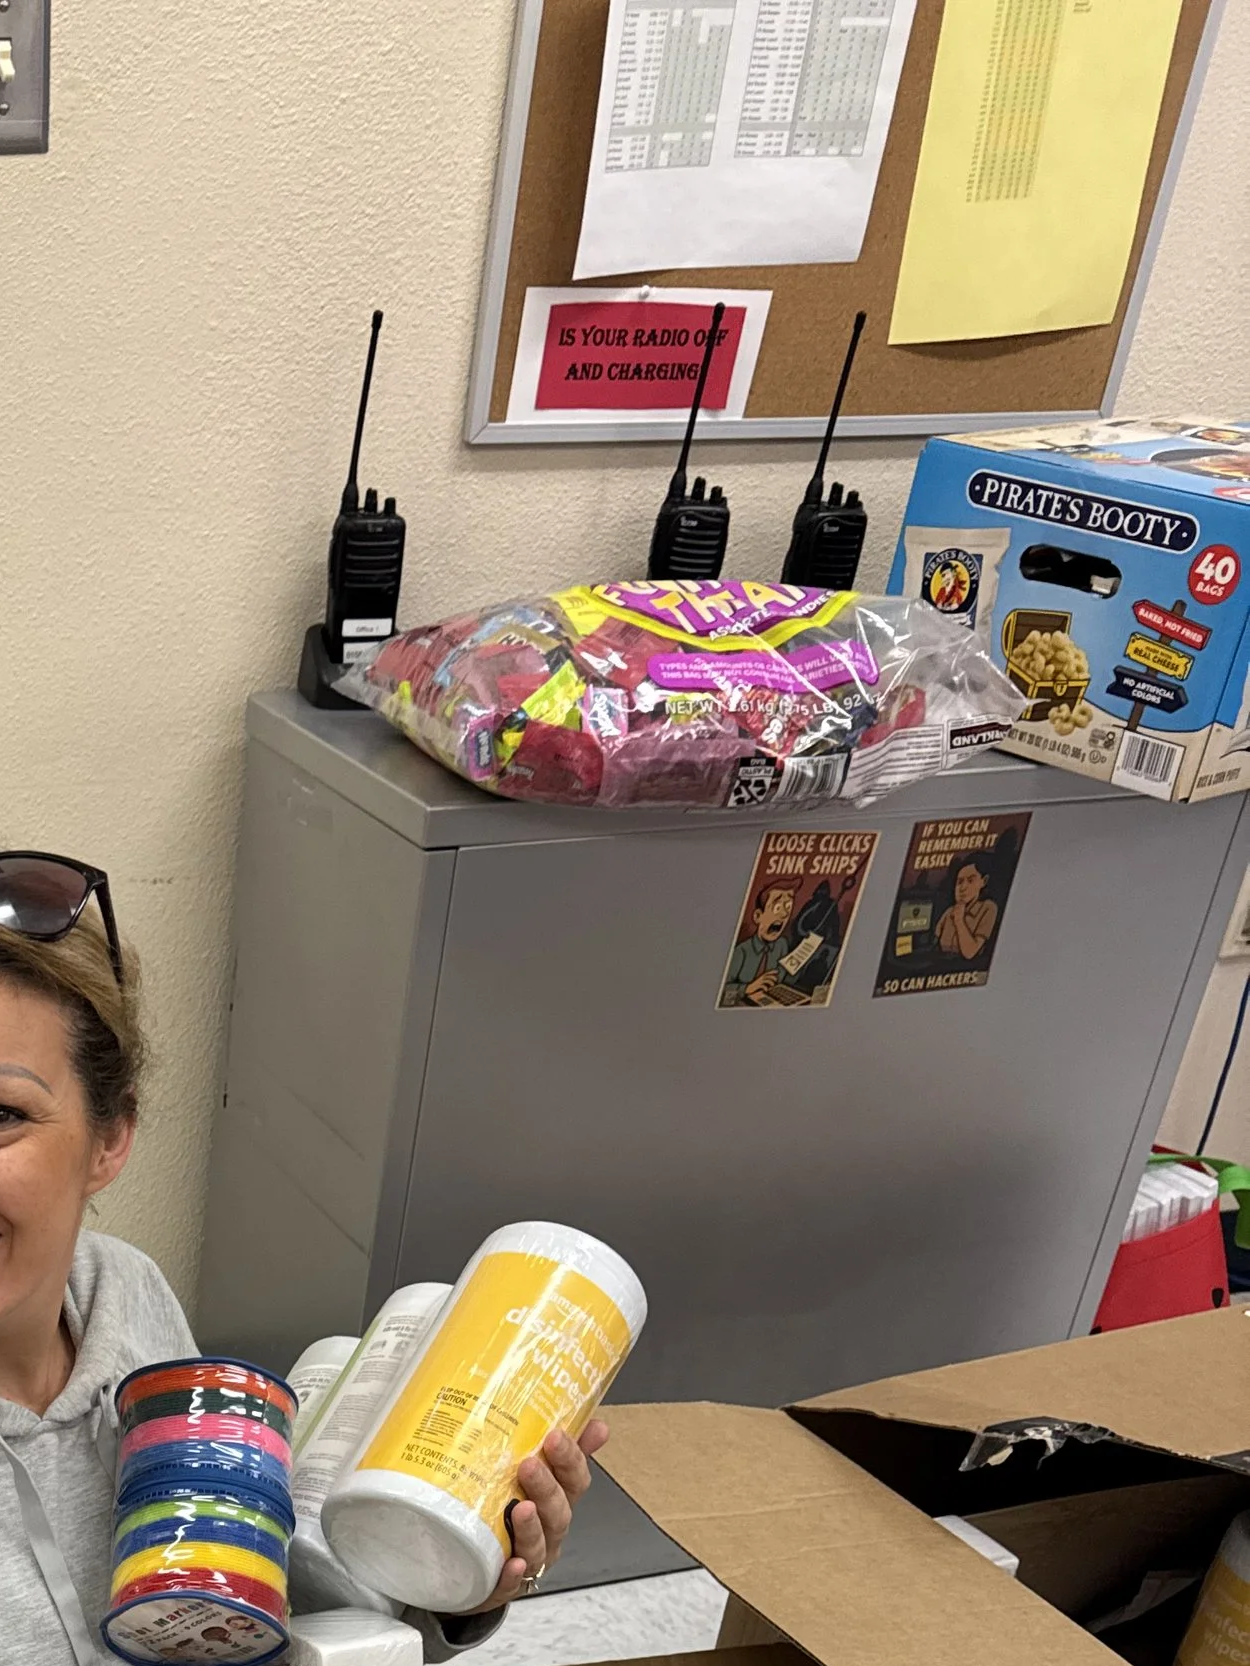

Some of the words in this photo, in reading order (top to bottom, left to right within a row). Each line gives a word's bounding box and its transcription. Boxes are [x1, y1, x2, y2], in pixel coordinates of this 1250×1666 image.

[558, 328, 576, 346] IS
[581, 325, 627, 347] YOUR
[632, 328, 689, 347] RADIO
[693, 329, 729, 347] OF
[564, 362, 603, 381] AND
[981, 478, 1085, 523] PIRATE'S
[1087, 503, 1181, 546] BOOTY
[1195, 552, 1237, 585] 40
[1195, 581, 1226, 597] BAGS
[1139, 608, 1164, 626] BAKED,
[1165, 620, 1181, 633] NOT
[1180, 627, 1203, 643] FRIED
[1152, 655, 1179, 672] CHEESE
[1123, 678, 1135, 687] NO
[1136, 682, 1174, 700] ARTIFICIAL
[1131, 689, 1161, 704] COLORS
[665, 701, 694, 715] NET
[758, 700, 774, 715] kg
[843, 694, 862, 711] 92
[922, 824, 936, 837] IF
[937, 821, 964, 836] YOU
[966, 819, 989, 835] CAN
[767, 834, 817, 853] LOOSE
[819, 834, 872, 853] CLICKS
[918, 835, 982, 853] REMEMBER
[983, 834, 997, 848] IT
[766, 855, 807, 875] SINK
[809, 855, 860, 875] SHIPS
[914, 855, 952, 870] EASILY
[883, 978, 900, 994] SO
[900, 976, 926, 992] CAN
[927, 972, 978, 990] HACKERS
[436, 1392, 467, 1406] CAUTION
[405, 1443, 418, 1454] NET
[405, 1453, 414, 1462] lb
[414, 1456, 425, 1466] 5.3
[426, 1461, 434, 1469] oz
[153, 1600, 213, 1628] Marker
